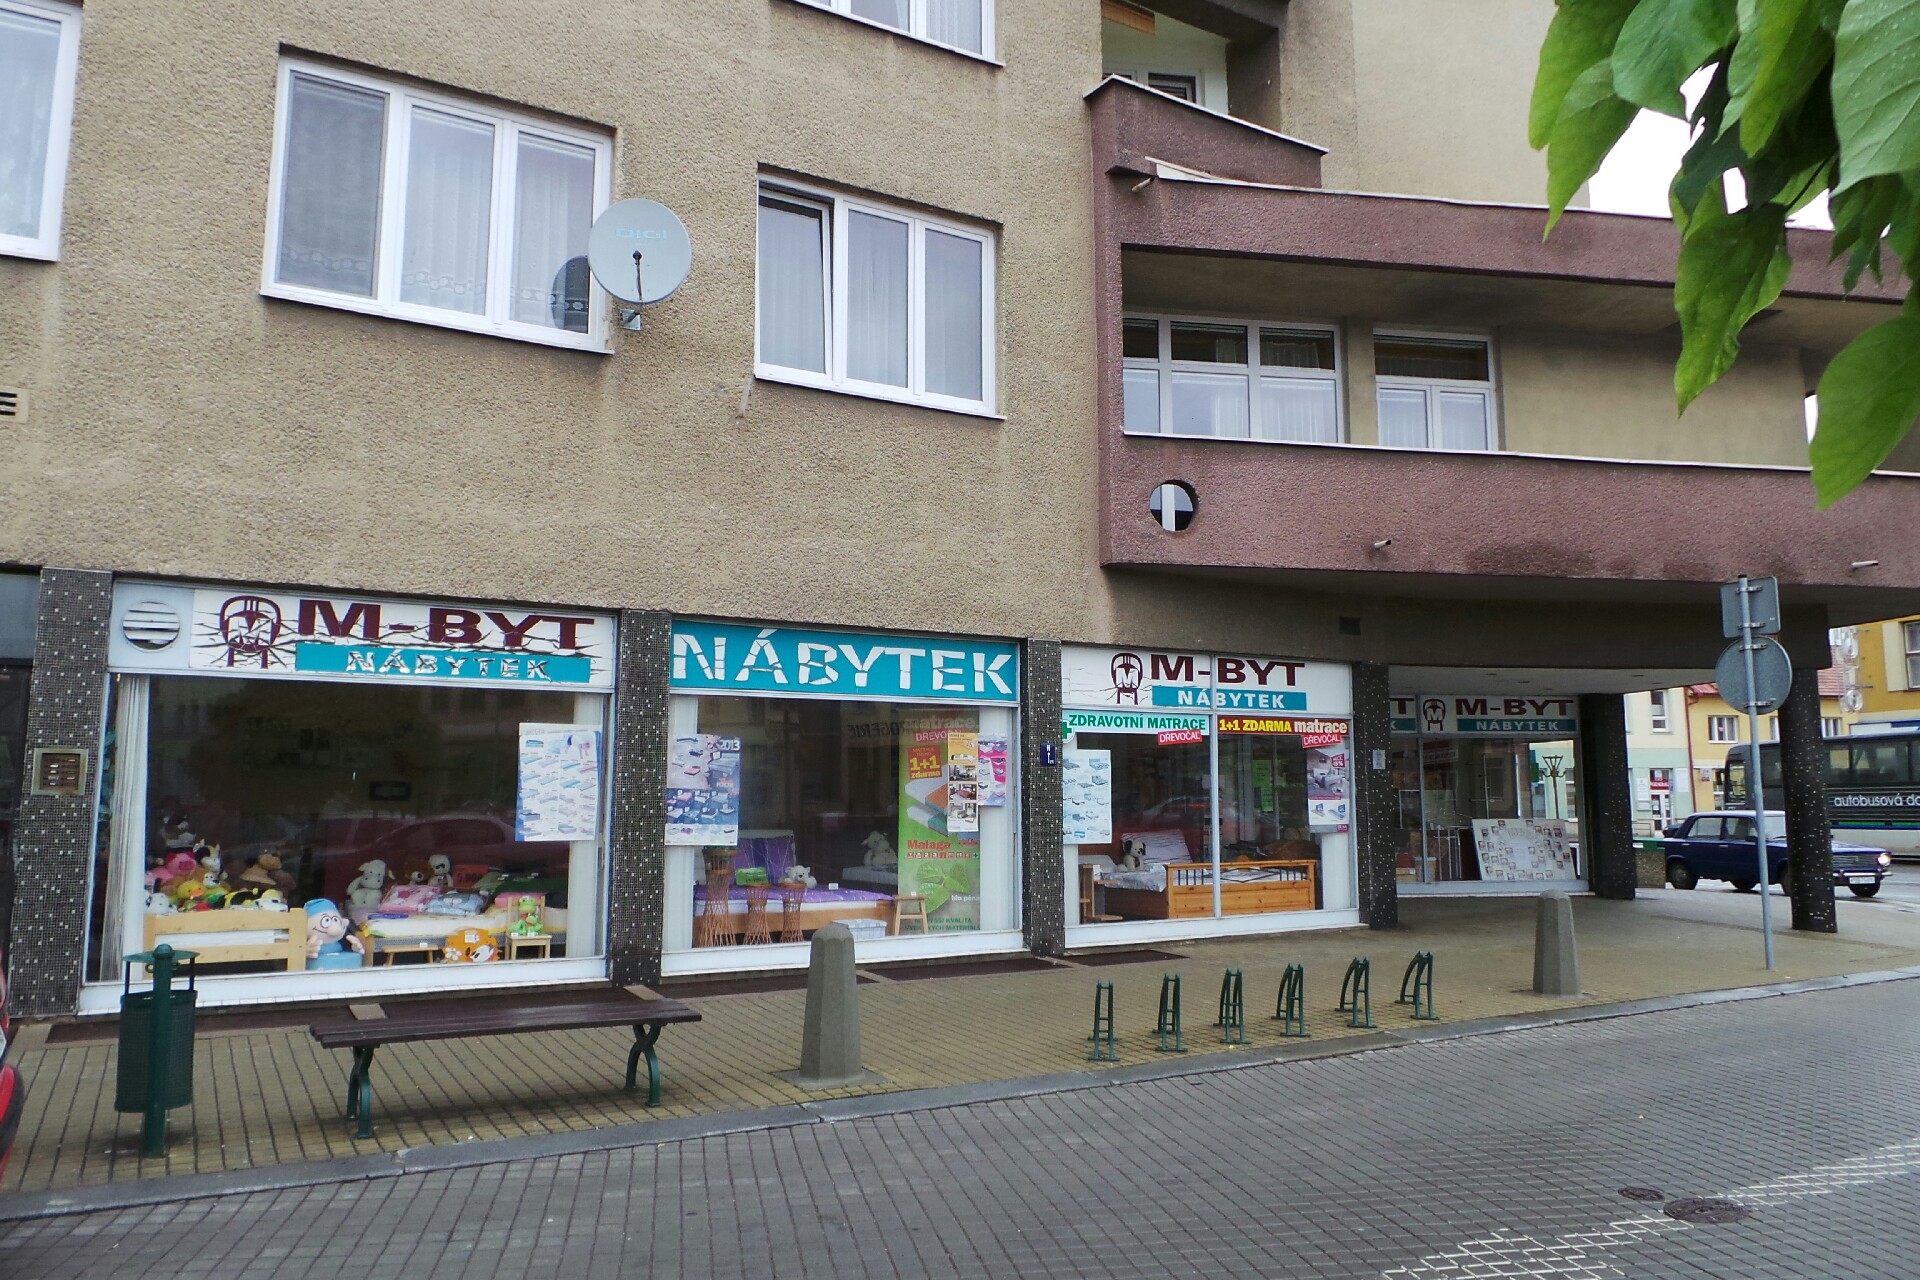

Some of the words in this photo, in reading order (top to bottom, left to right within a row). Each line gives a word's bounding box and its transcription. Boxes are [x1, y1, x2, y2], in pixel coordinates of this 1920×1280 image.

[615, 228, 669, 240] DIGI
[300, 599, 595, 650] M-BYT
[346, 650, 553, 682] NÁBYTEK
[673, 628, 1013, 694] NÁBYTEK
[1151, 654, 1305, 686] M-BYT
[1178, 688, 1285, 709] NÁBYTEK
[1455, 698, 1575, 716] M-BYT
[1069, 713, 1144, 729] ZDRAVOTNÍ
[1147, 717, 1206, 730] MATRACE
[1219, 719, 1240, 731] 1+1
[1243, 720, 1292, 732] ZDARMA
[1294, 719, 1347, 734] matrace
[1476, 719, 1559, 731] NÁBYTEK
[1159, 731, 1200, 743] DŘEVOČAL
[1303, 733, 1340, 745] DŘEVOČAL
[720, 740, 740, 751] 2013
[910, 756, 940, 771] 1+1
[911, 771, 940, 779] zdarma
[1834, 793, 1903, 807] autobusová
